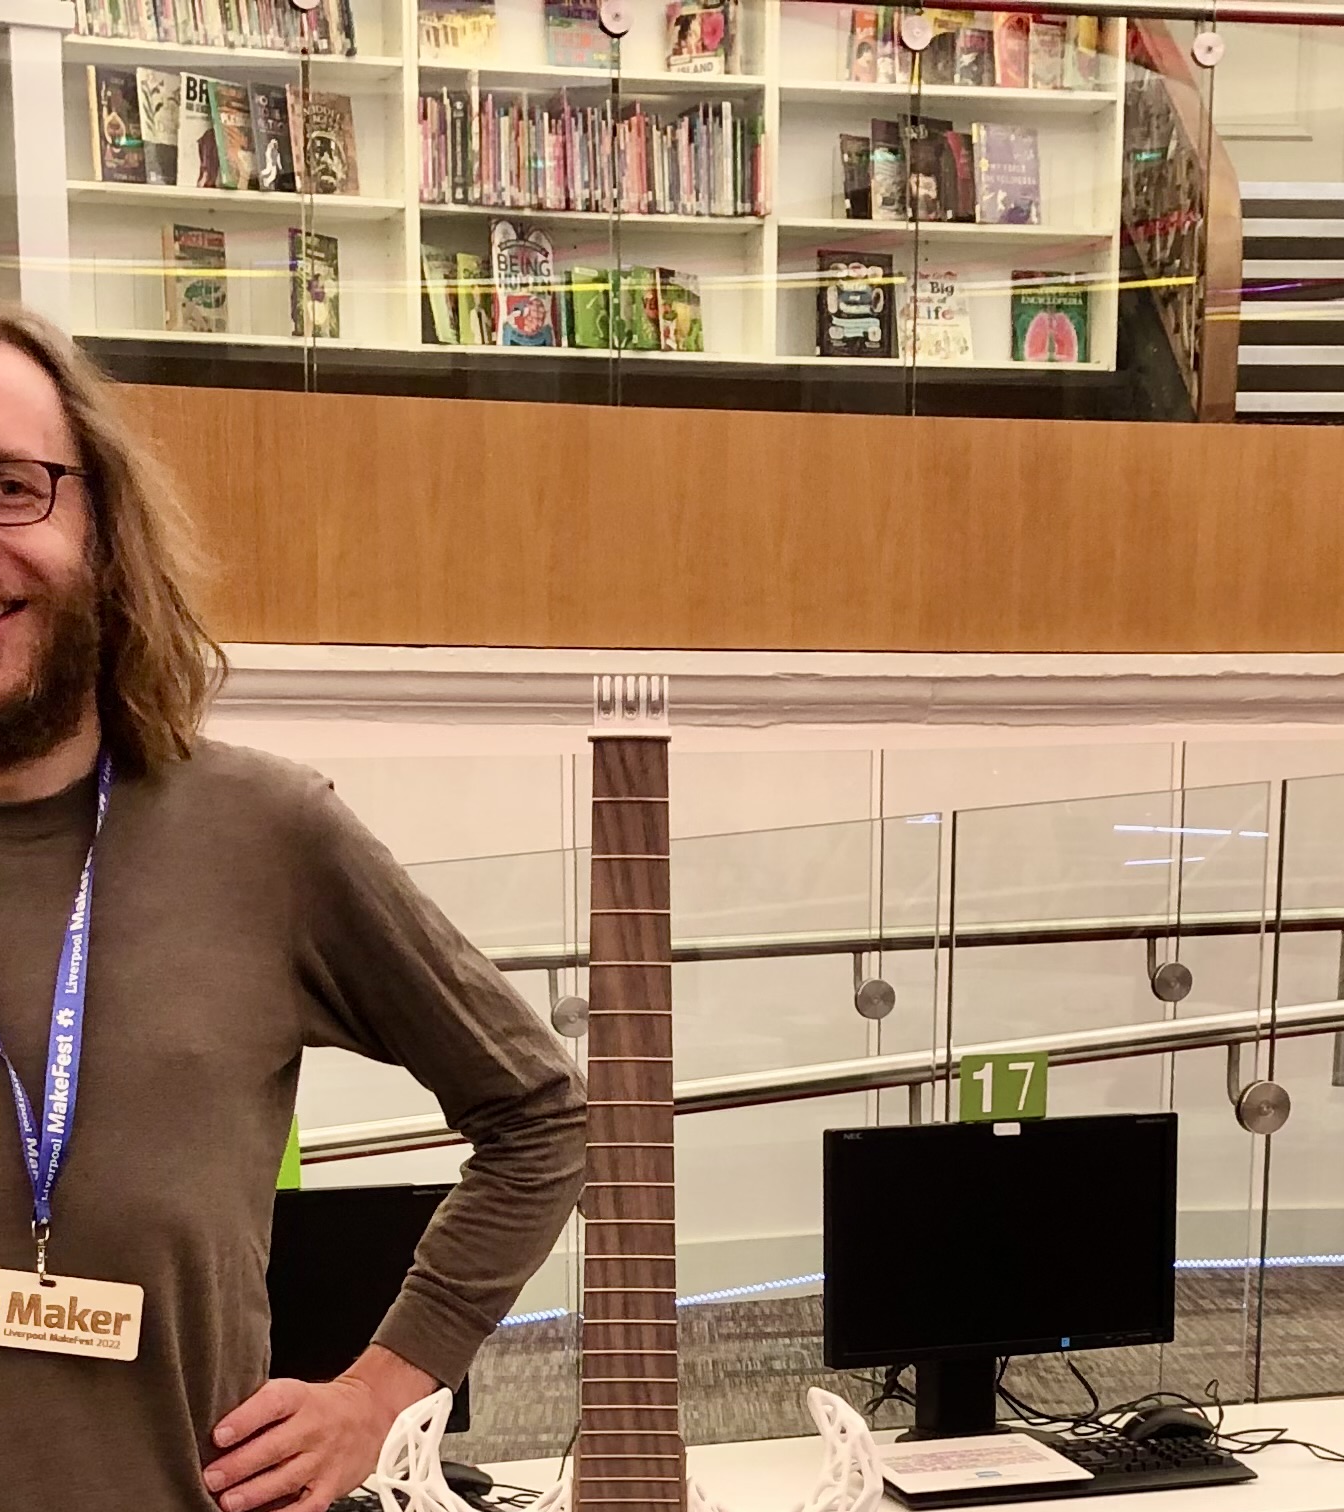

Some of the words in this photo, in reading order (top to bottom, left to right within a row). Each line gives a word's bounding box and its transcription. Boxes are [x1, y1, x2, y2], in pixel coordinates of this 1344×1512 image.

[497, 253, 550, 277] BEING
[929, 281, 955, 296] Big
[65, 934, 83, 994] Liverpool
[47, 1034, 74, 1134] MakeFest
[972, 1060, 1036, 1114] 17
[843, 1132, 864, 1140] NEC
[41, 1138, 63, 1200] Liverpool
[6, 1291, 132, 1336] Maker
[4, 1327, 47, 1341] Liverpool
[49, 1333, 94, 1346] MakeFest
[96, 1338, 121, 1350] 2022
